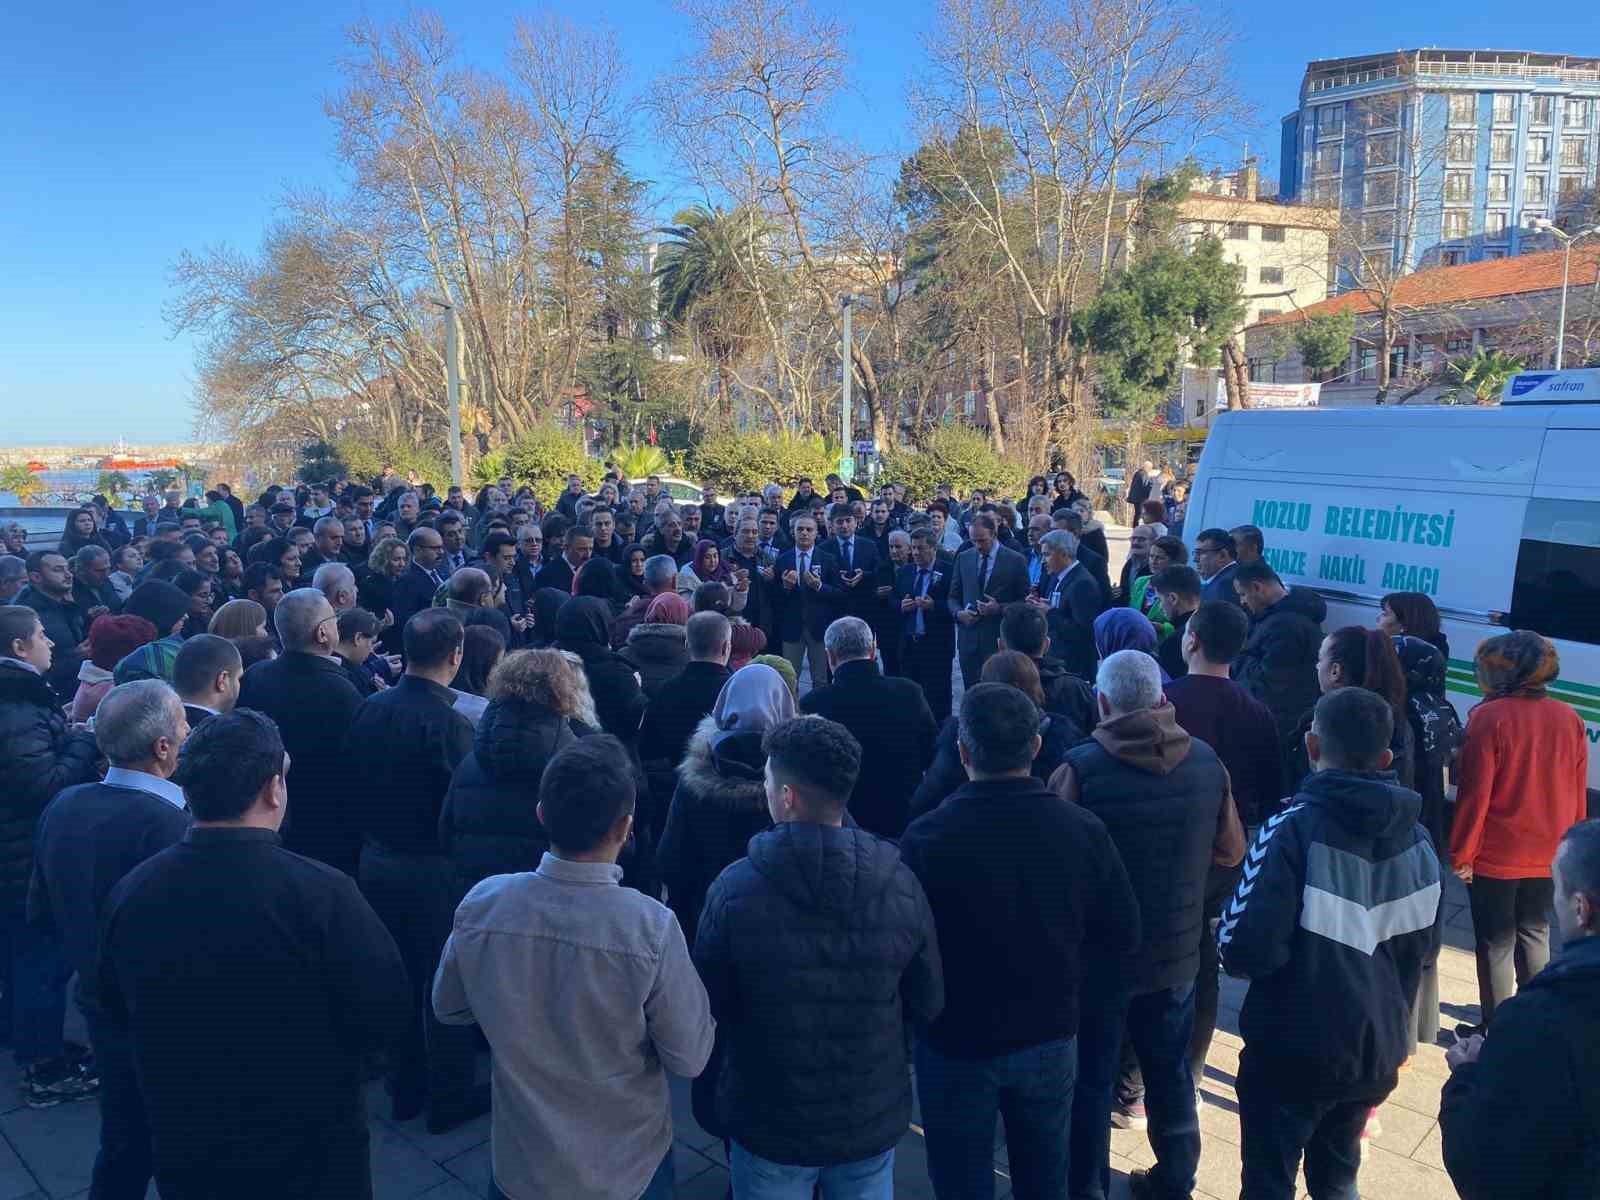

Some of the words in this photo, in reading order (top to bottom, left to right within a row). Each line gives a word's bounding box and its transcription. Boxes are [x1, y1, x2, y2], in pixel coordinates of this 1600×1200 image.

[1549, 380, 1584, 392] safran
[1253, 500, 1311, 531] KOZLU
[1324, 504, 1455, 547] BELEDİYESİ
[1264, 548, 1306, 576] ENAZE
[1319, 553, 1365, 585] NAKİL
